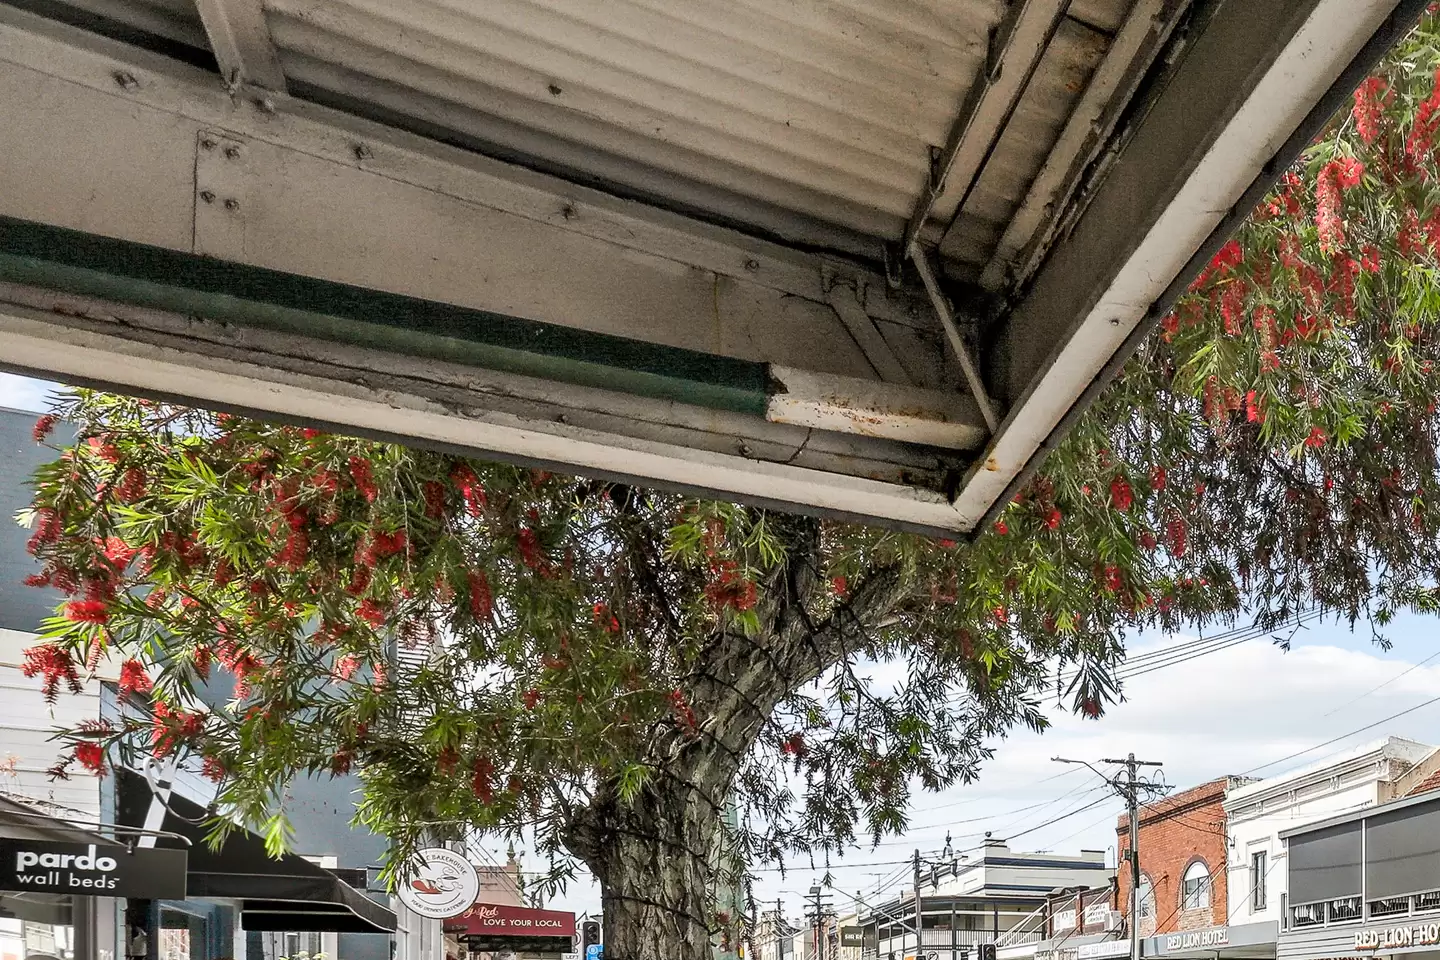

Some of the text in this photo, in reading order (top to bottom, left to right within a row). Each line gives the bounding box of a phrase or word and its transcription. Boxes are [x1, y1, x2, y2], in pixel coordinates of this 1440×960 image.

[16, 844, 118, 872] pardo
[431, 854, 468, 876] BAKEHOUSE
[17, 872, 60, 886] wall
[483, 918, 562, 928] LOVE YOUR LOCAL
[1167, 928, 1229, 950] RED LION HOTEL
[1354, 931, 1380, 950] RED
[1384, 926, 1415, 947] LION
